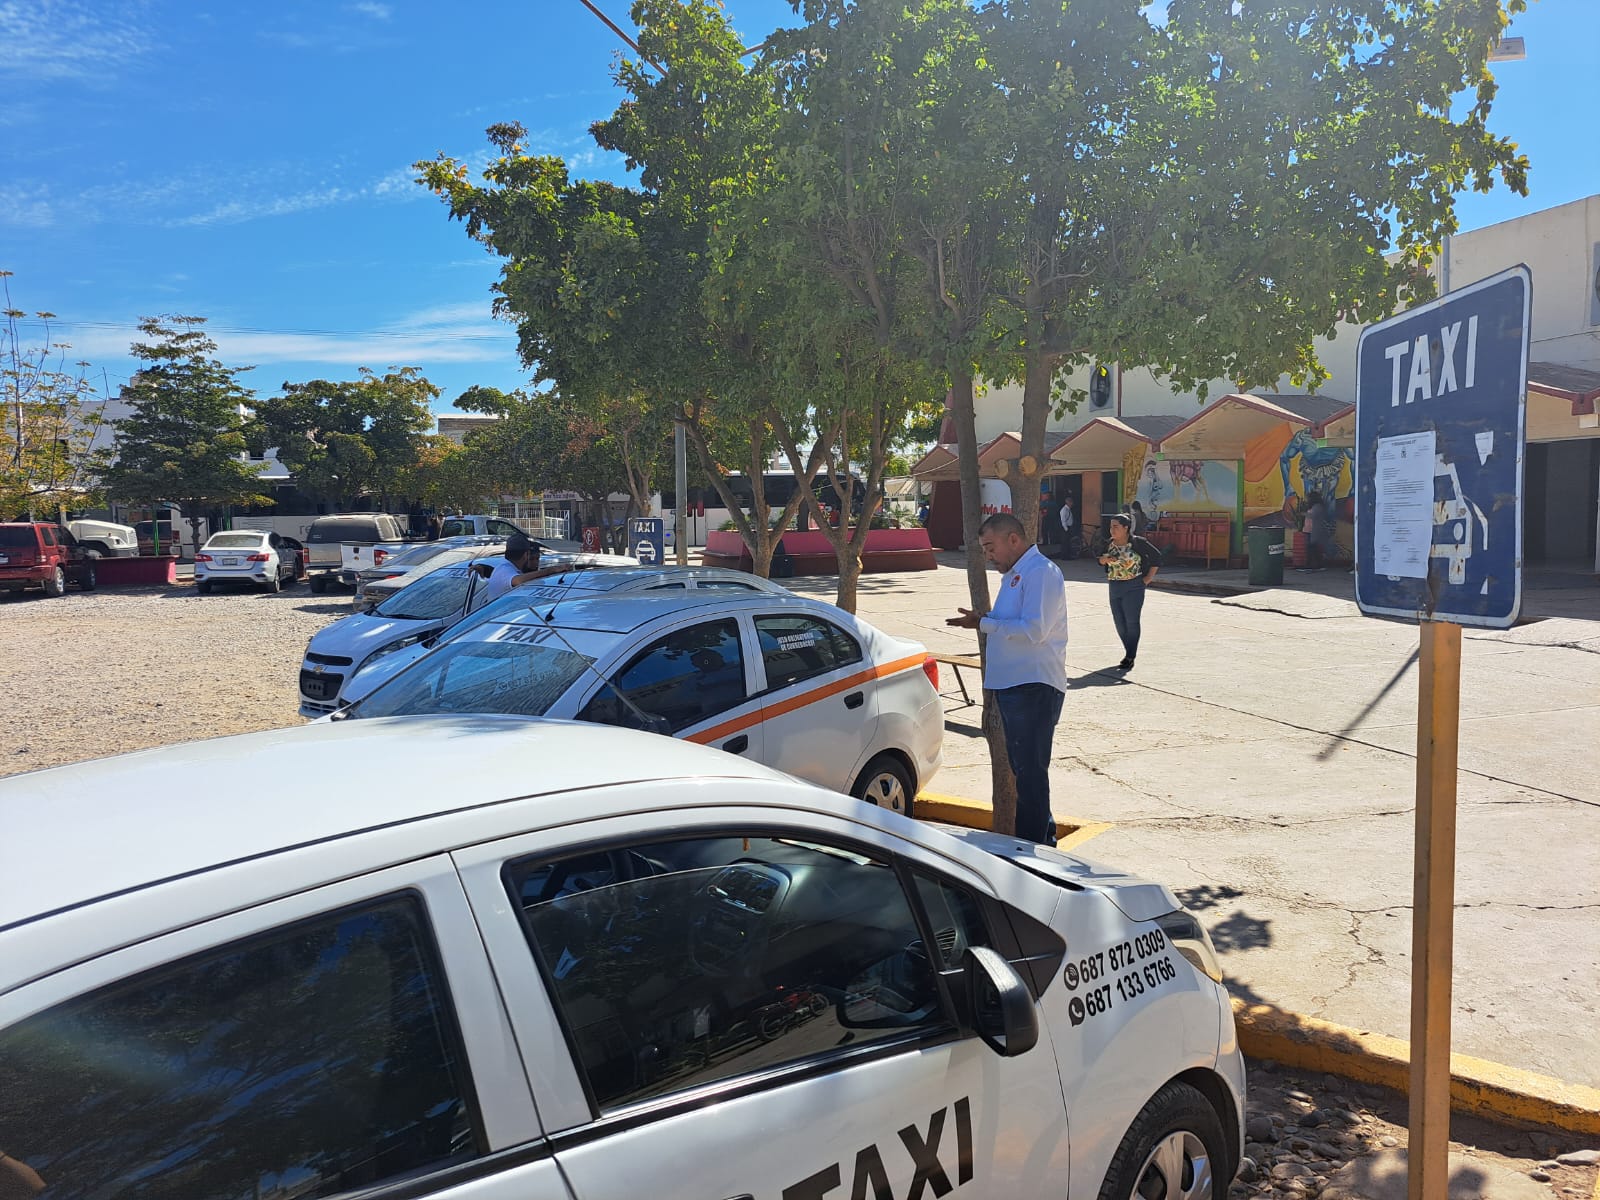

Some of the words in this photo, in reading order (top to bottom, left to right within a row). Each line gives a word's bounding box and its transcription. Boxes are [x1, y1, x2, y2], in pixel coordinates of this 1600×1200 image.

[1385, 315, 1479, 408] TAXI
[633, 521, 656, 533] TAXI
[528, 587, 567, 598] TAXI
[496, 626, 556, 644] TAXI
[1080, 952, 1105, 984] 687
[1108, 942, 1136, 971] 872
[1135, 929, 1166, 960] 0309
[1085, 984, 1113, 1017] 687
[1116, 971, 1145, 1002] 133
[1143, 956, 1176, 988] 6766
